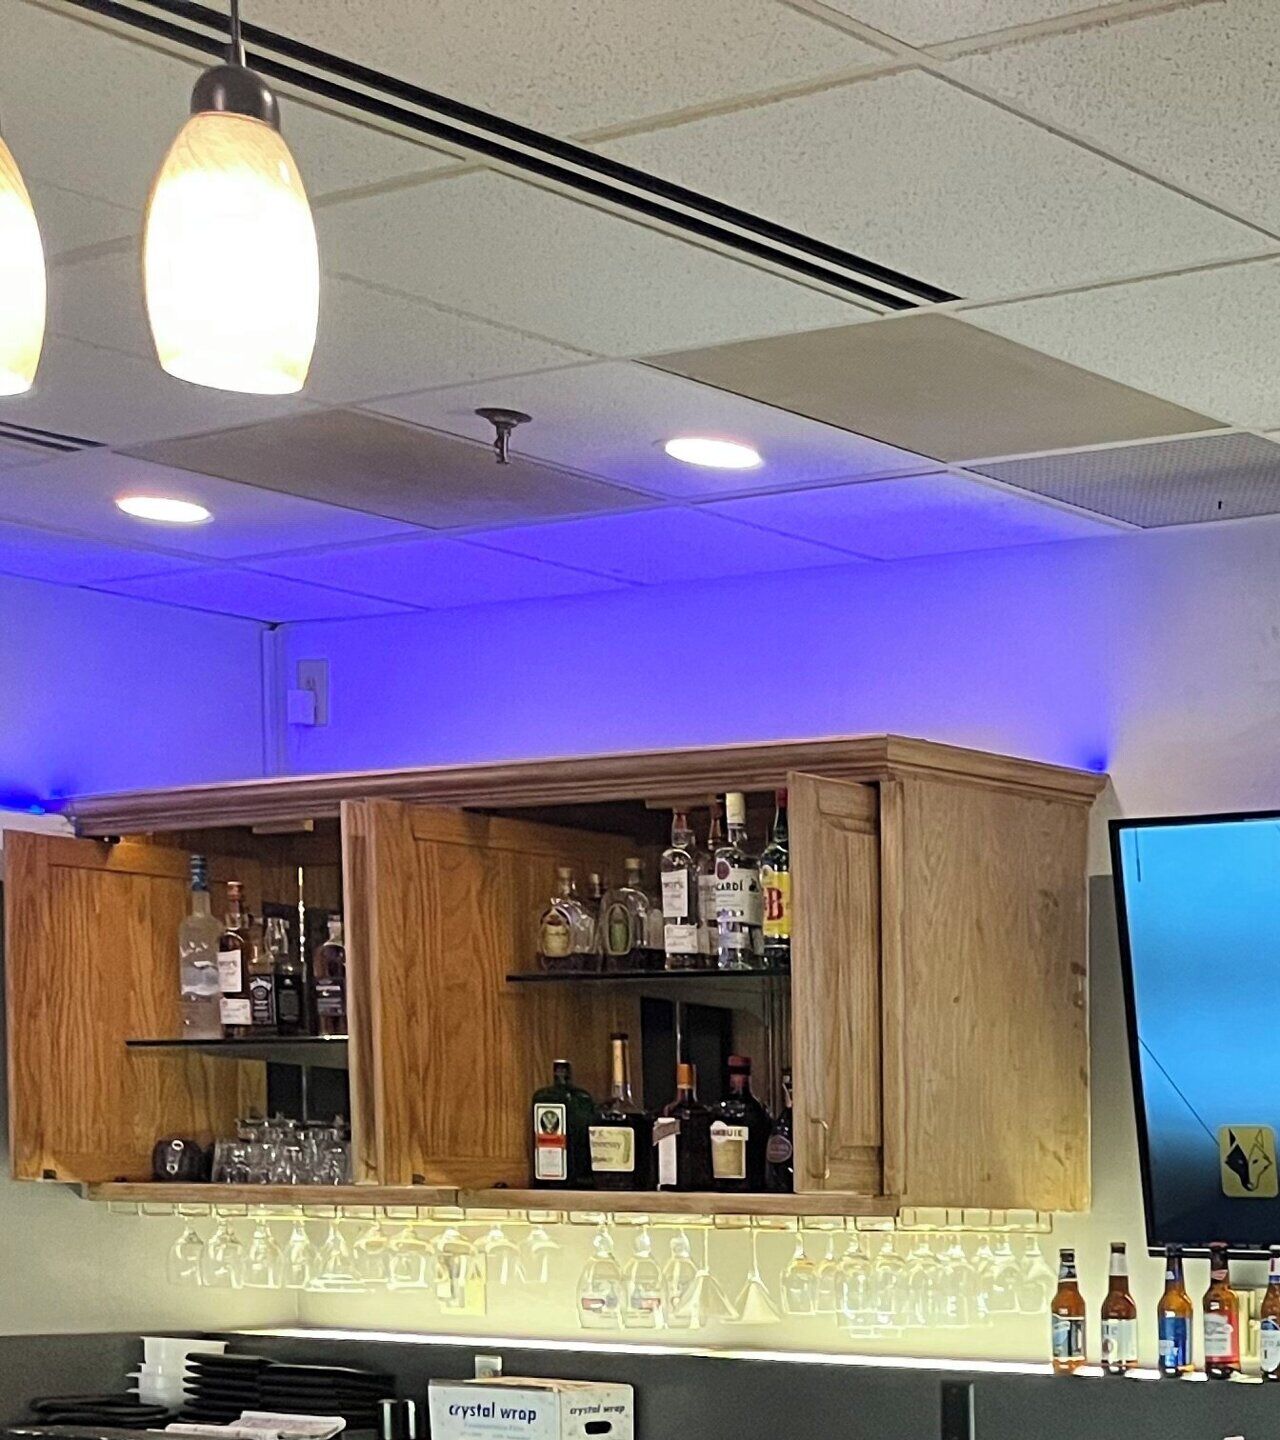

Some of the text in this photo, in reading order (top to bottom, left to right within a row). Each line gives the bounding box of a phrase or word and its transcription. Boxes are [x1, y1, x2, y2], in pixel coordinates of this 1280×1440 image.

[716, 880, 744, 892] CARDÍ
[449, 1401, 537, 1424] crystal wrap
[570, 1404, 626, 1416] crystal wrap
